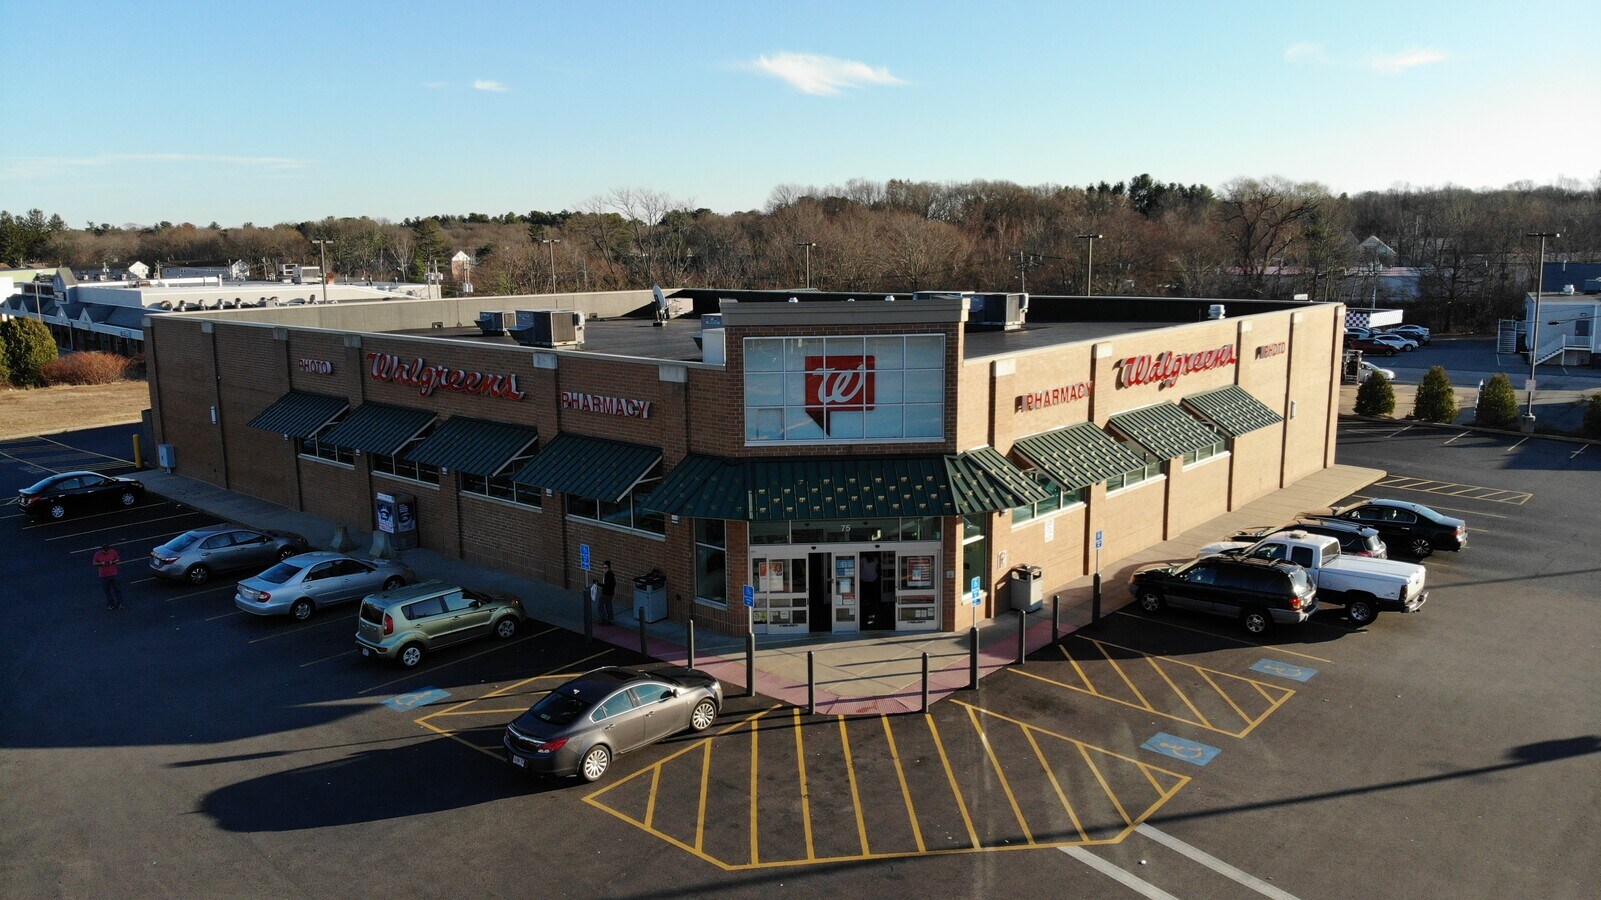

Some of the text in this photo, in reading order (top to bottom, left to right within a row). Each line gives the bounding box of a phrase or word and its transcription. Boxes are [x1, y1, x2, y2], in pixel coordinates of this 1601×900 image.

[1262, 342, 1286, 359] PHOTO
[299, 358, 331, 374] PHOTO
[366, 352, 525, 398] Walgreens
[1120, 344, 1237, 388] Walgreens
[561, 391, 650, 419] PHARMACY
[1025, 381, 1094, 409] PHARMACY
[840, 524, 851, 532] 75
